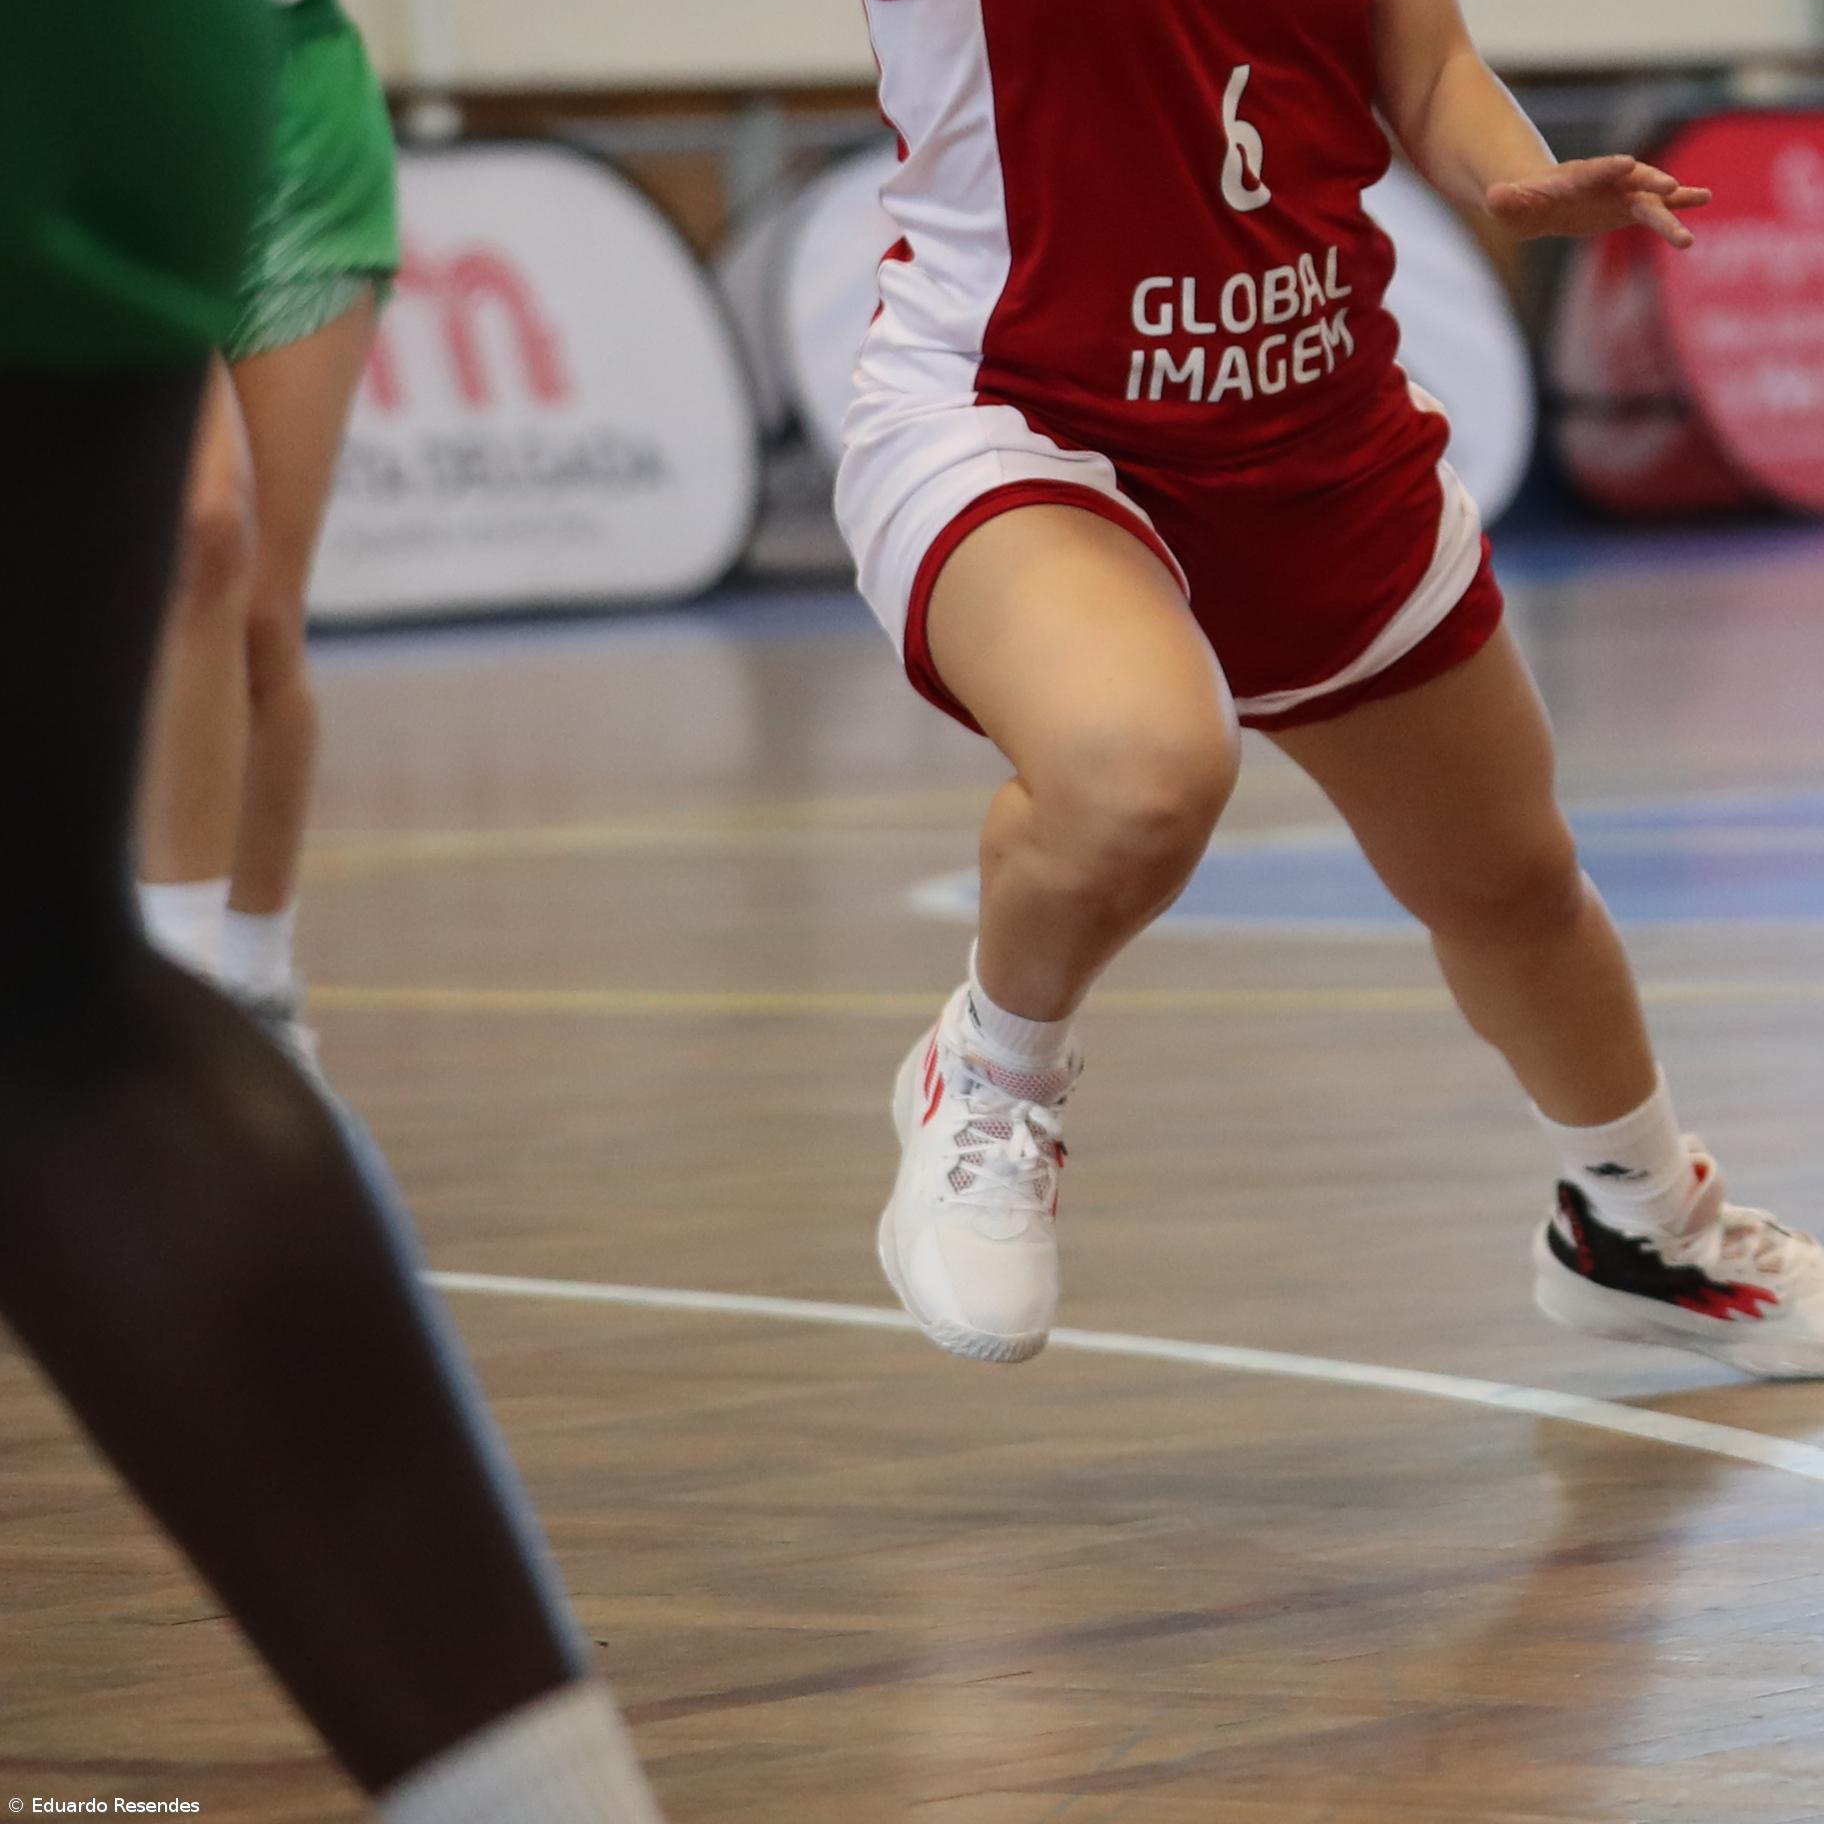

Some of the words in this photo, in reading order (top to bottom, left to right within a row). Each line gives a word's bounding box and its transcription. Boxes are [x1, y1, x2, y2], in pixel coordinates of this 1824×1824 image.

[1220, 63, 1272, 212] 6
[1131, 245, 1352, 337] GLOBAL
[1125, 307, 1355, 403] IMAGEM
